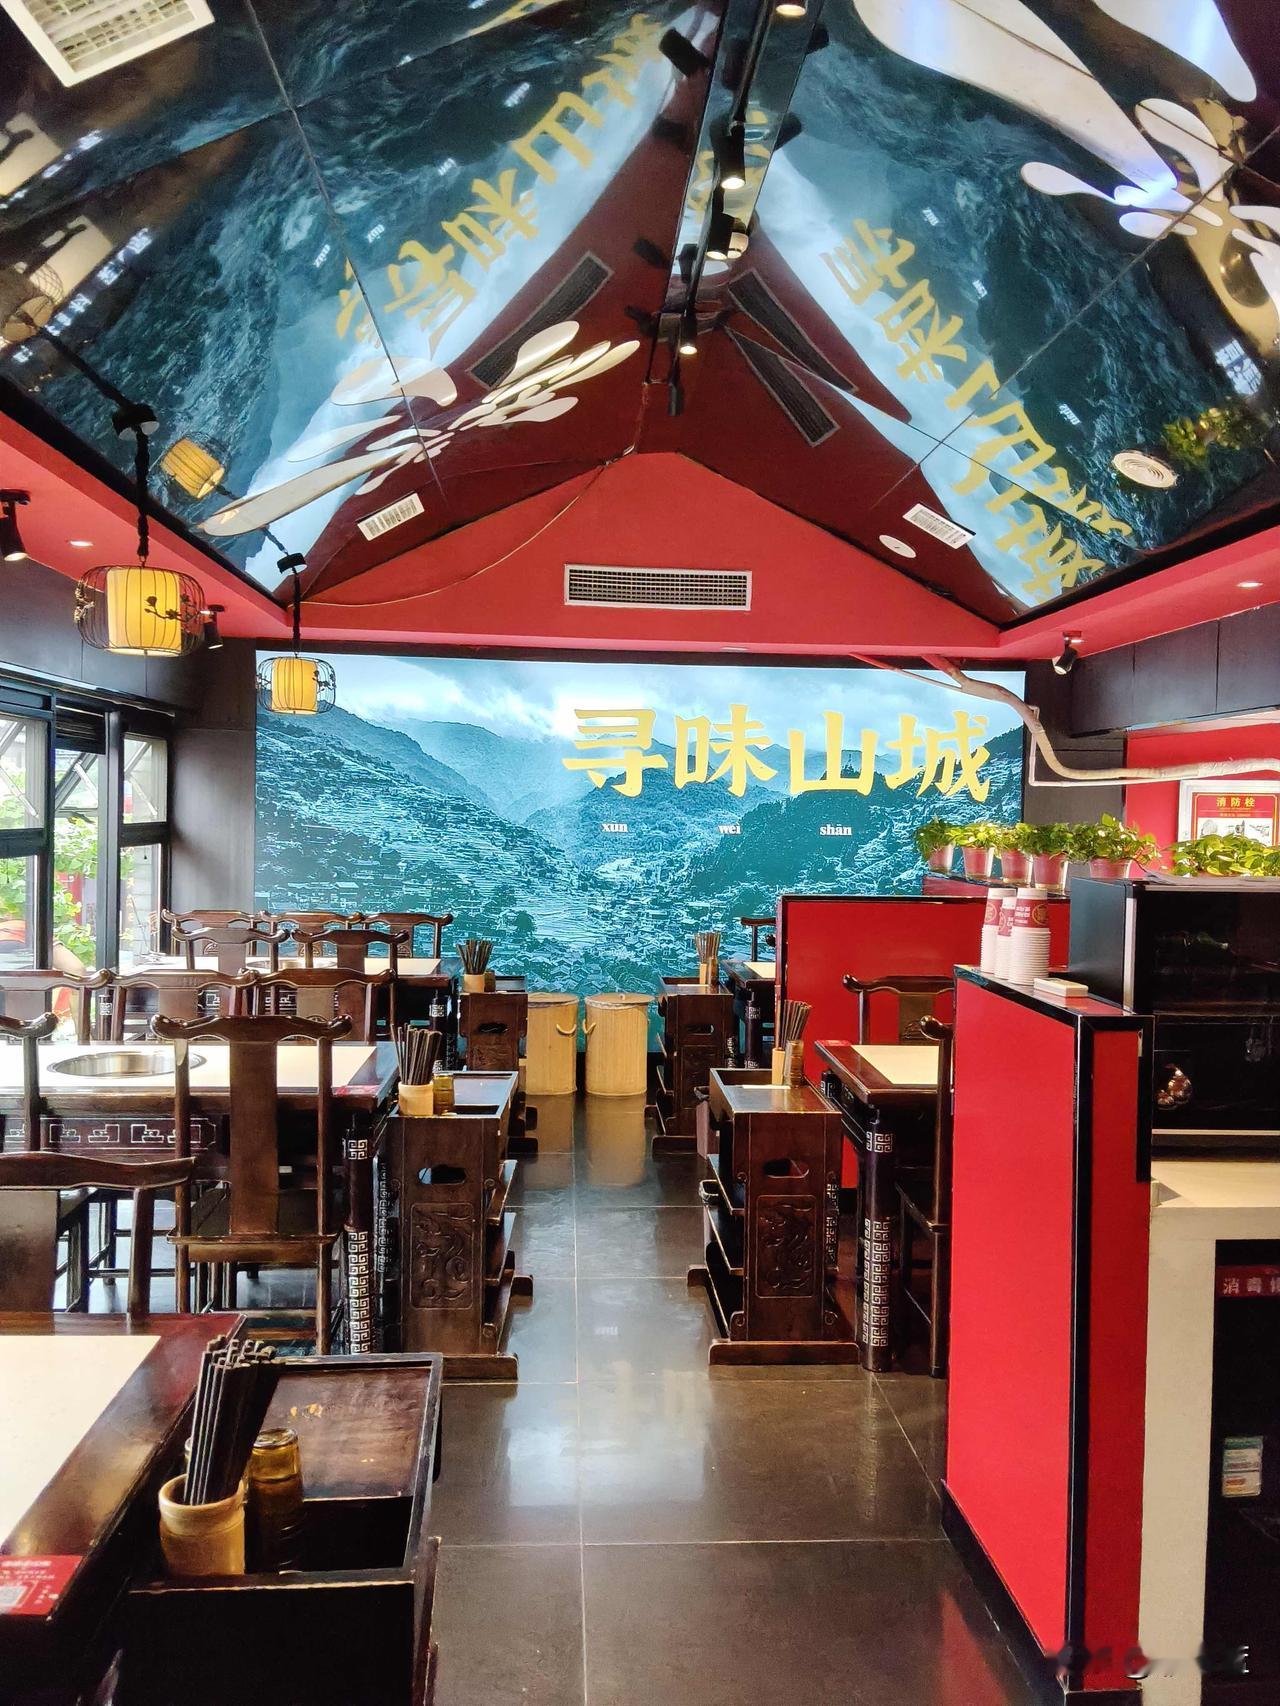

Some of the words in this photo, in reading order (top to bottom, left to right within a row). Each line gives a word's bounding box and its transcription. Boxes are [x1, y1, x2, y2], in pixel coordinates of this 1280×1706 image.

[562, 703, 991, 803] 寻味山城
[1216, 796, 1256, 808] 消防栓
